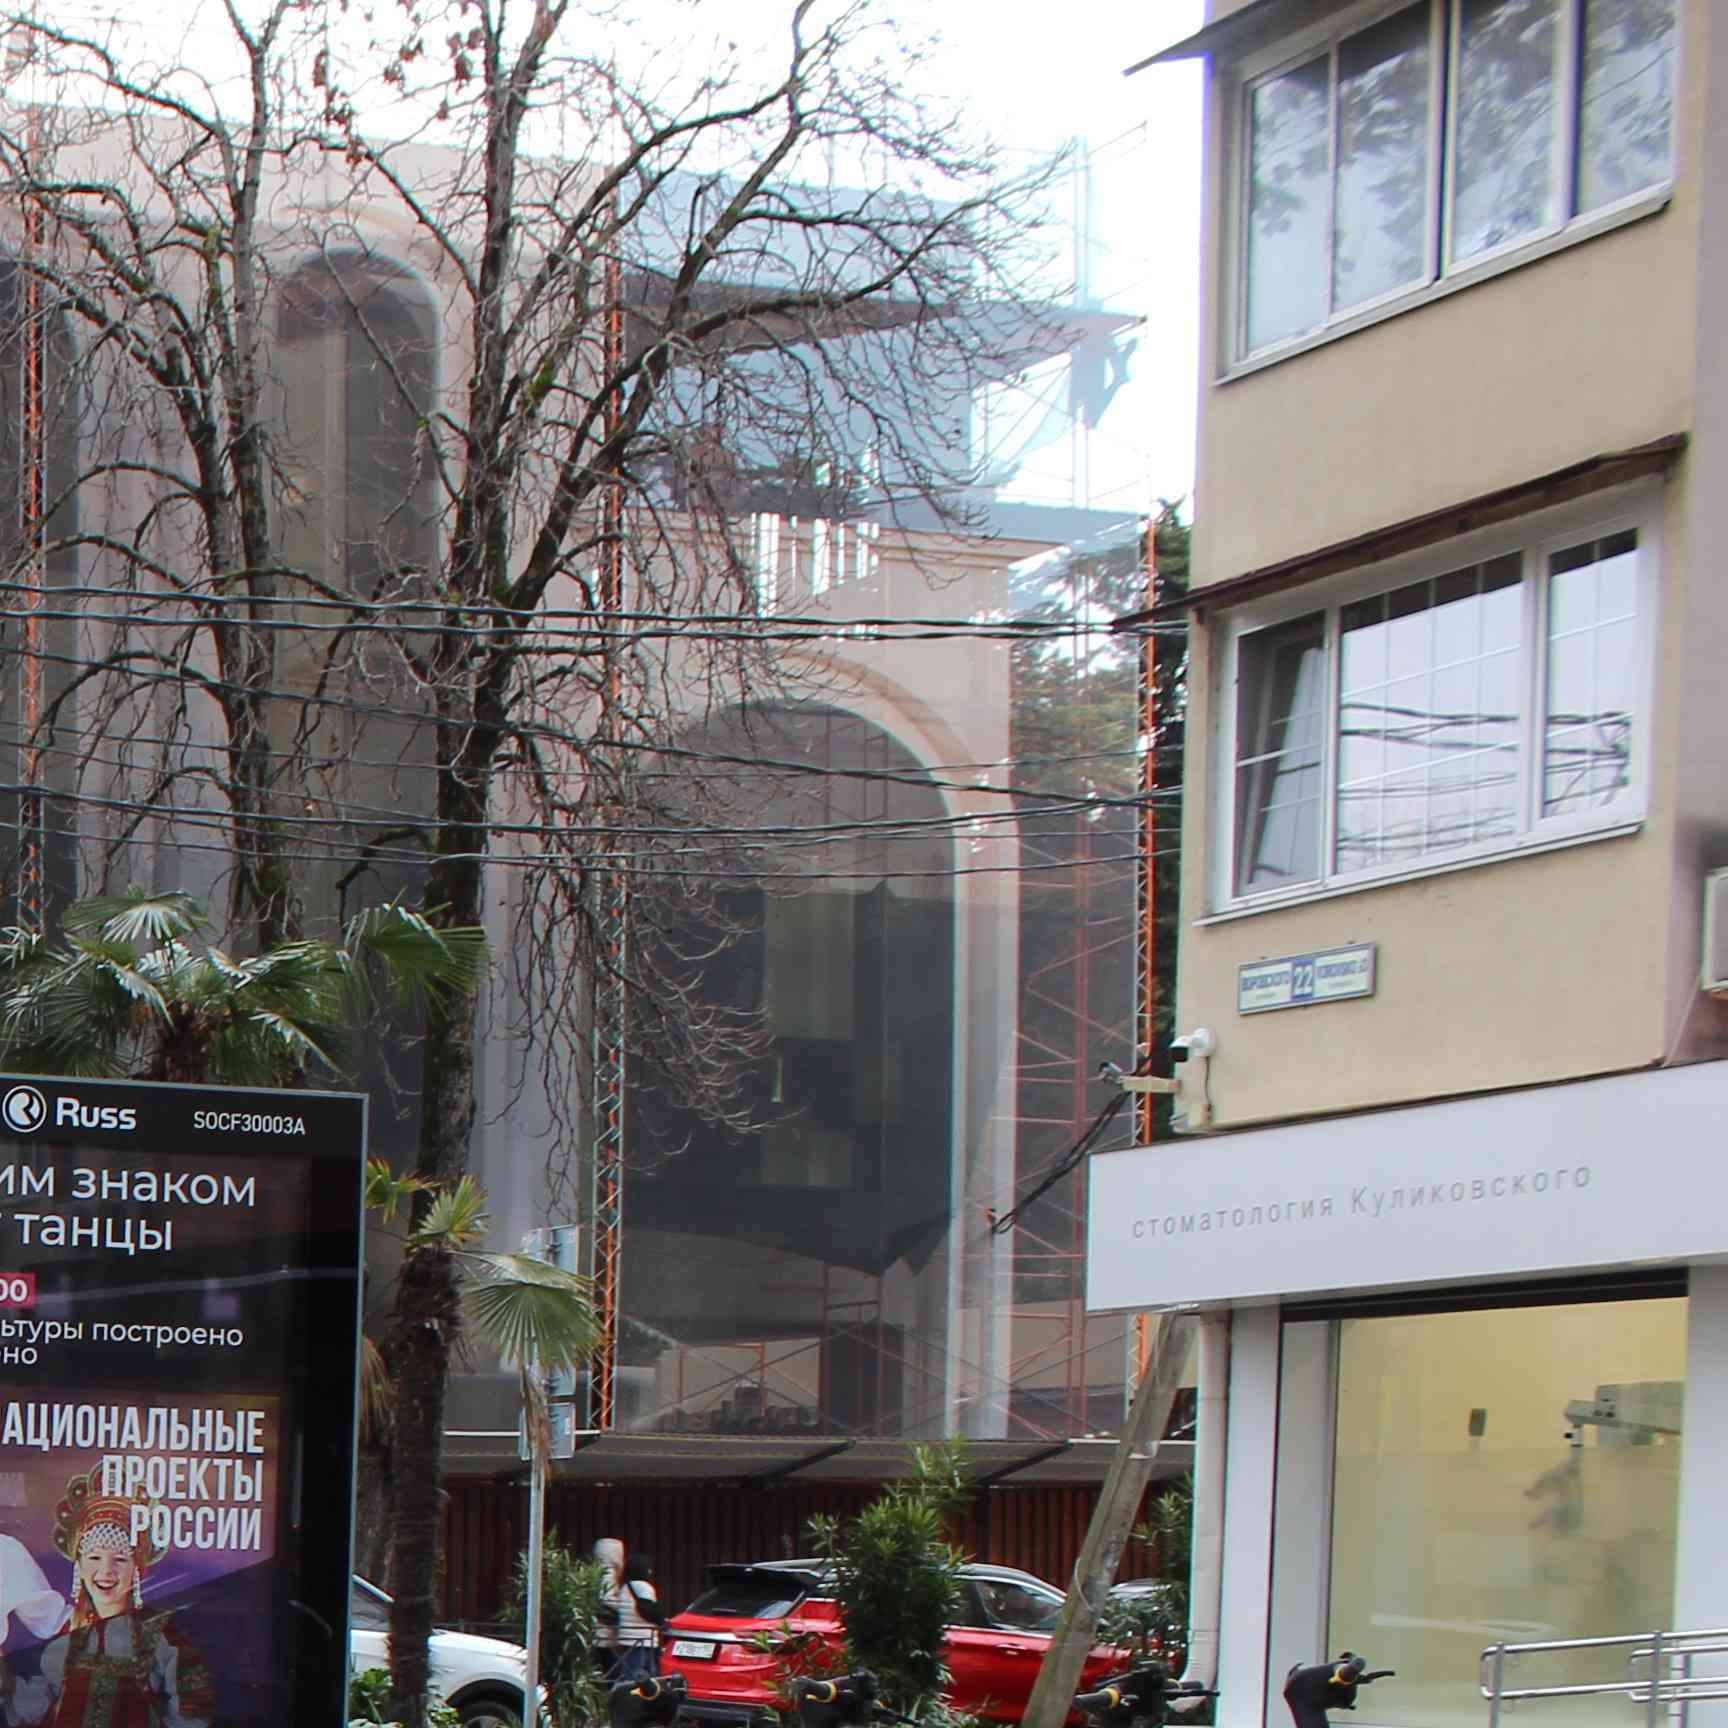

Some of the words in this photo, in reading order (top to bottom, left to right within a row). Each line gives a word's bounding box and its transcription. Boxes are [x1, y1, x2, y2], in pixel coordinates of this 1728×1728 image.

[1294, 965, 1313, 995] 22
[56, 1097, 137, 1131] Russ
[193, 1111, 305, 1135] SOCF30003A
[71, 1168, 256, 1207] знаком
[1132, 1195, 1334, 1241] стоматология
[1351, 1164, 1592, 1220] Куликовского
[13, 1211, 173, 1256] танцы
[92, 1322, 243, 1350] построено
[102, 1454, 263, 1502] ПРОЕКТЫ
[129, 1504, 262, 1551] РОССИИ
